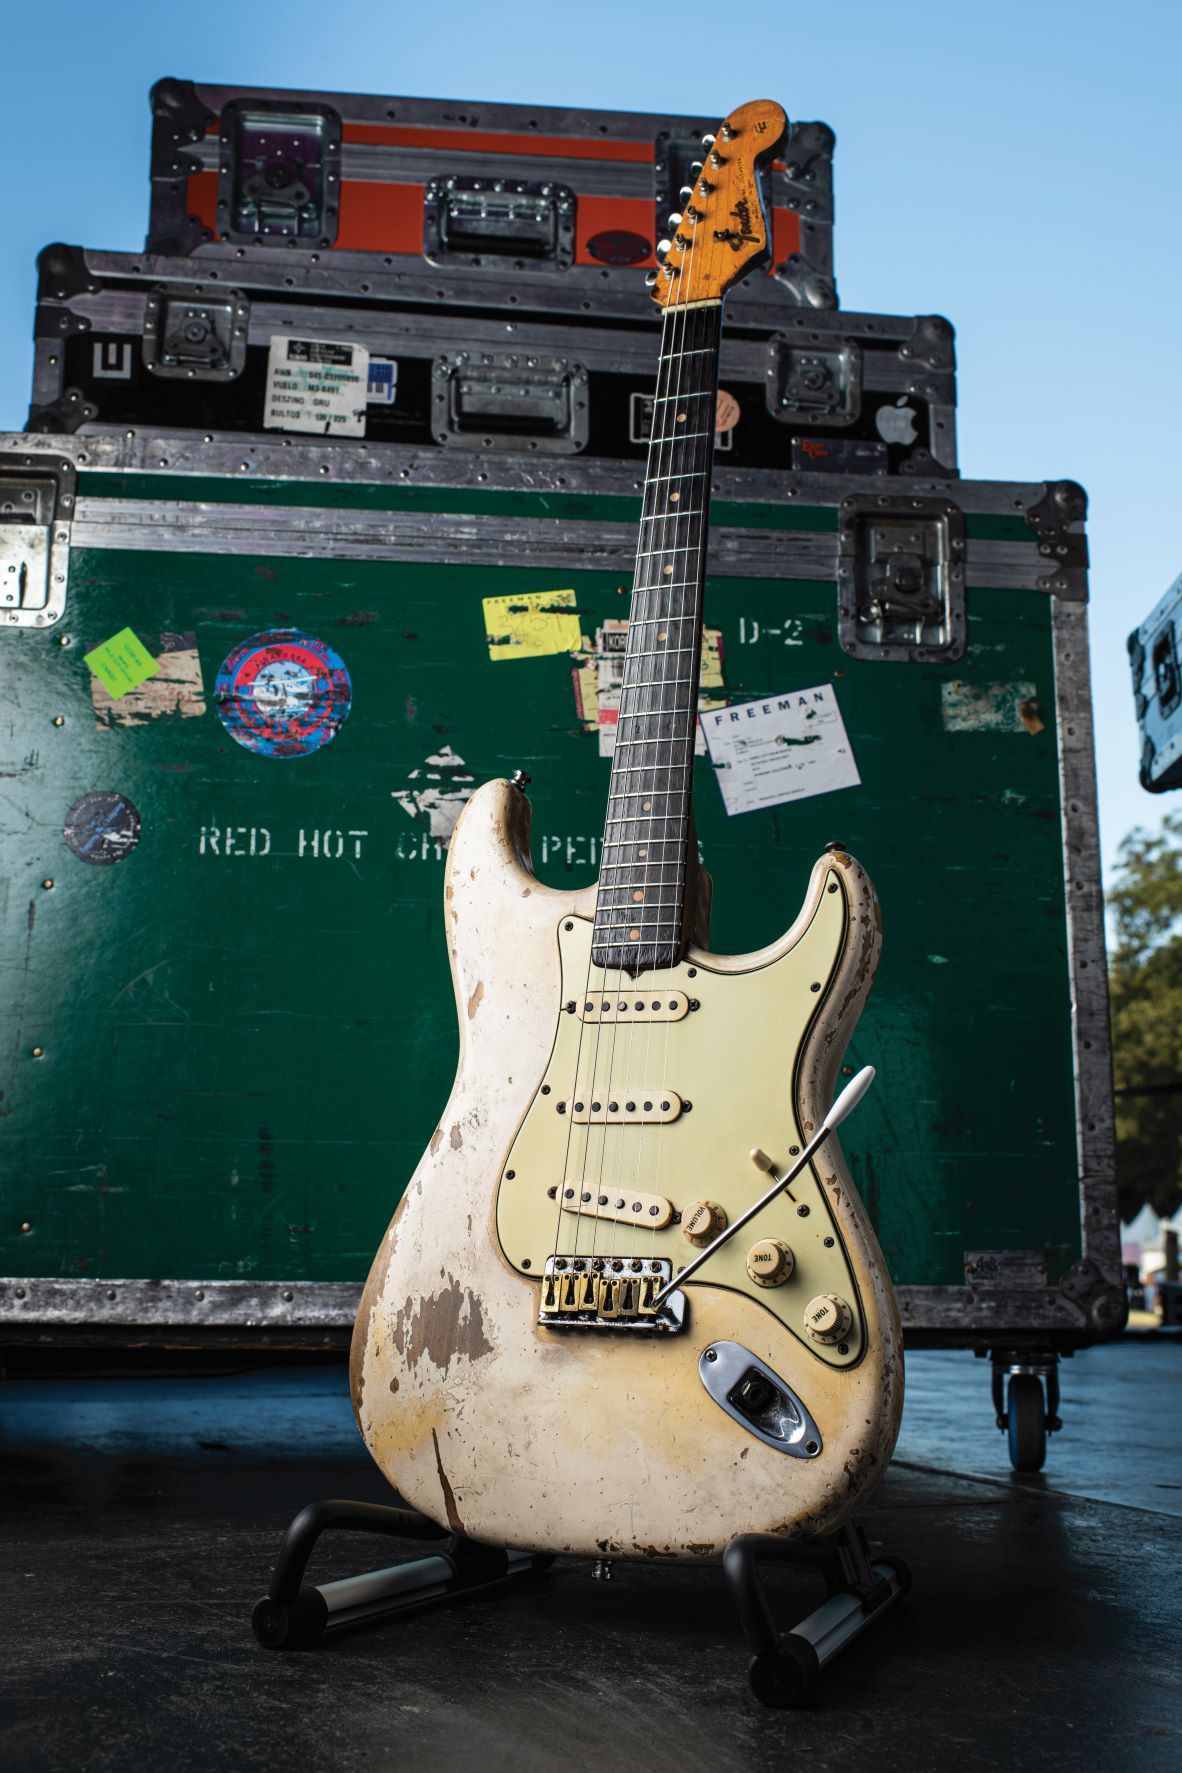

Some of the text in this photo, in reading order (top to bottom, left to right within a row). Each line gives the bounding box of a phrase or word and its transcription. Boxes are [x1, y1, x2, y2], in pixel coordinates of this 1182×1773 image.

[729, 196, 760, 251] Fender
[740, 617, 803, 645] D-2
[714, 692, 824, 726] FREEMAN
[199, 826, 271, 856] RED
[298, 828, 369, 859] HOT
[686, 1206, 706, 1231] VOLUME
[753, 1253, 772, 1263] TONE
[811, 1306, 830, 1324] TONE
